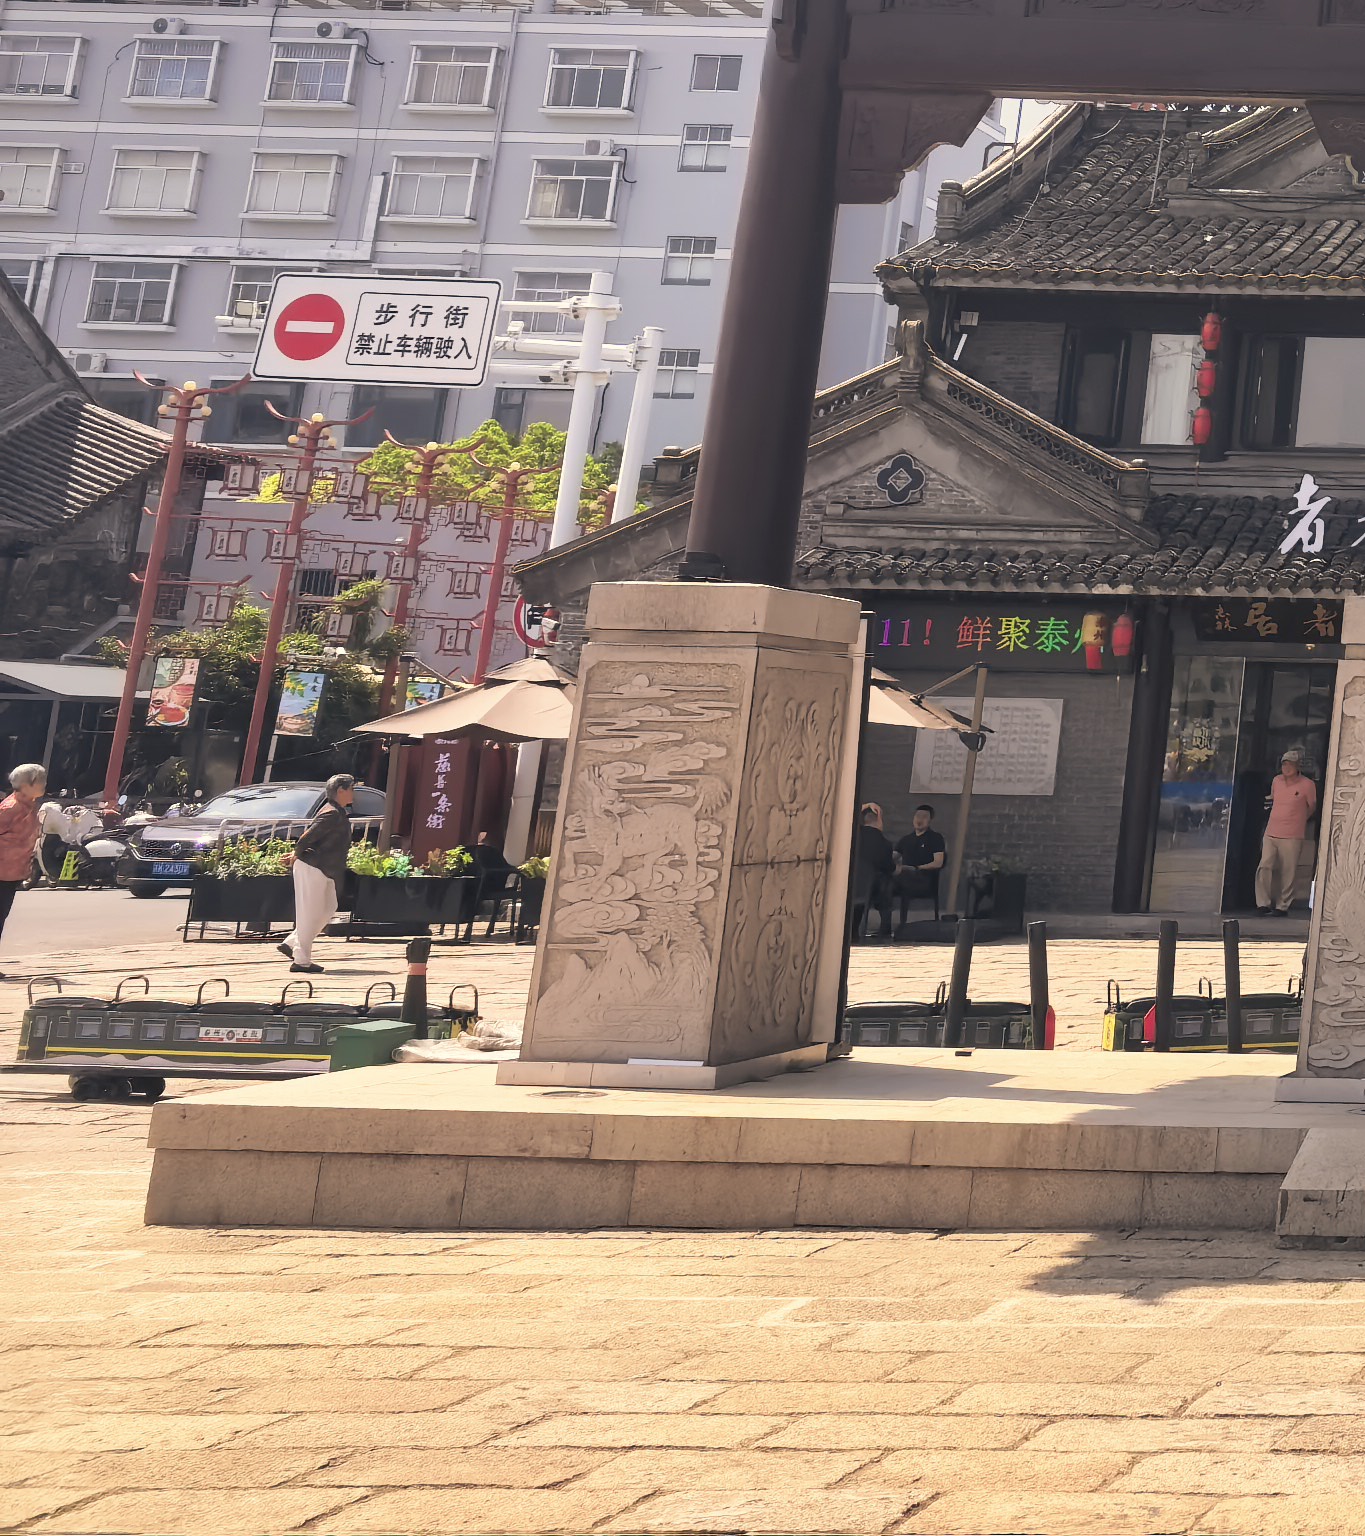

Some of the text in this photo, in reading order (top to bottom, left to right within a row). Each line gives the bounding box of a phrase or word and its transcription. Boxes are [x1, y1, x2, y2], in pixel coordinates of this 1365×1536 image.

[373, 303, 470, 329] 步行街
[353, 332, 473, 361] 禁止车辆驶入
